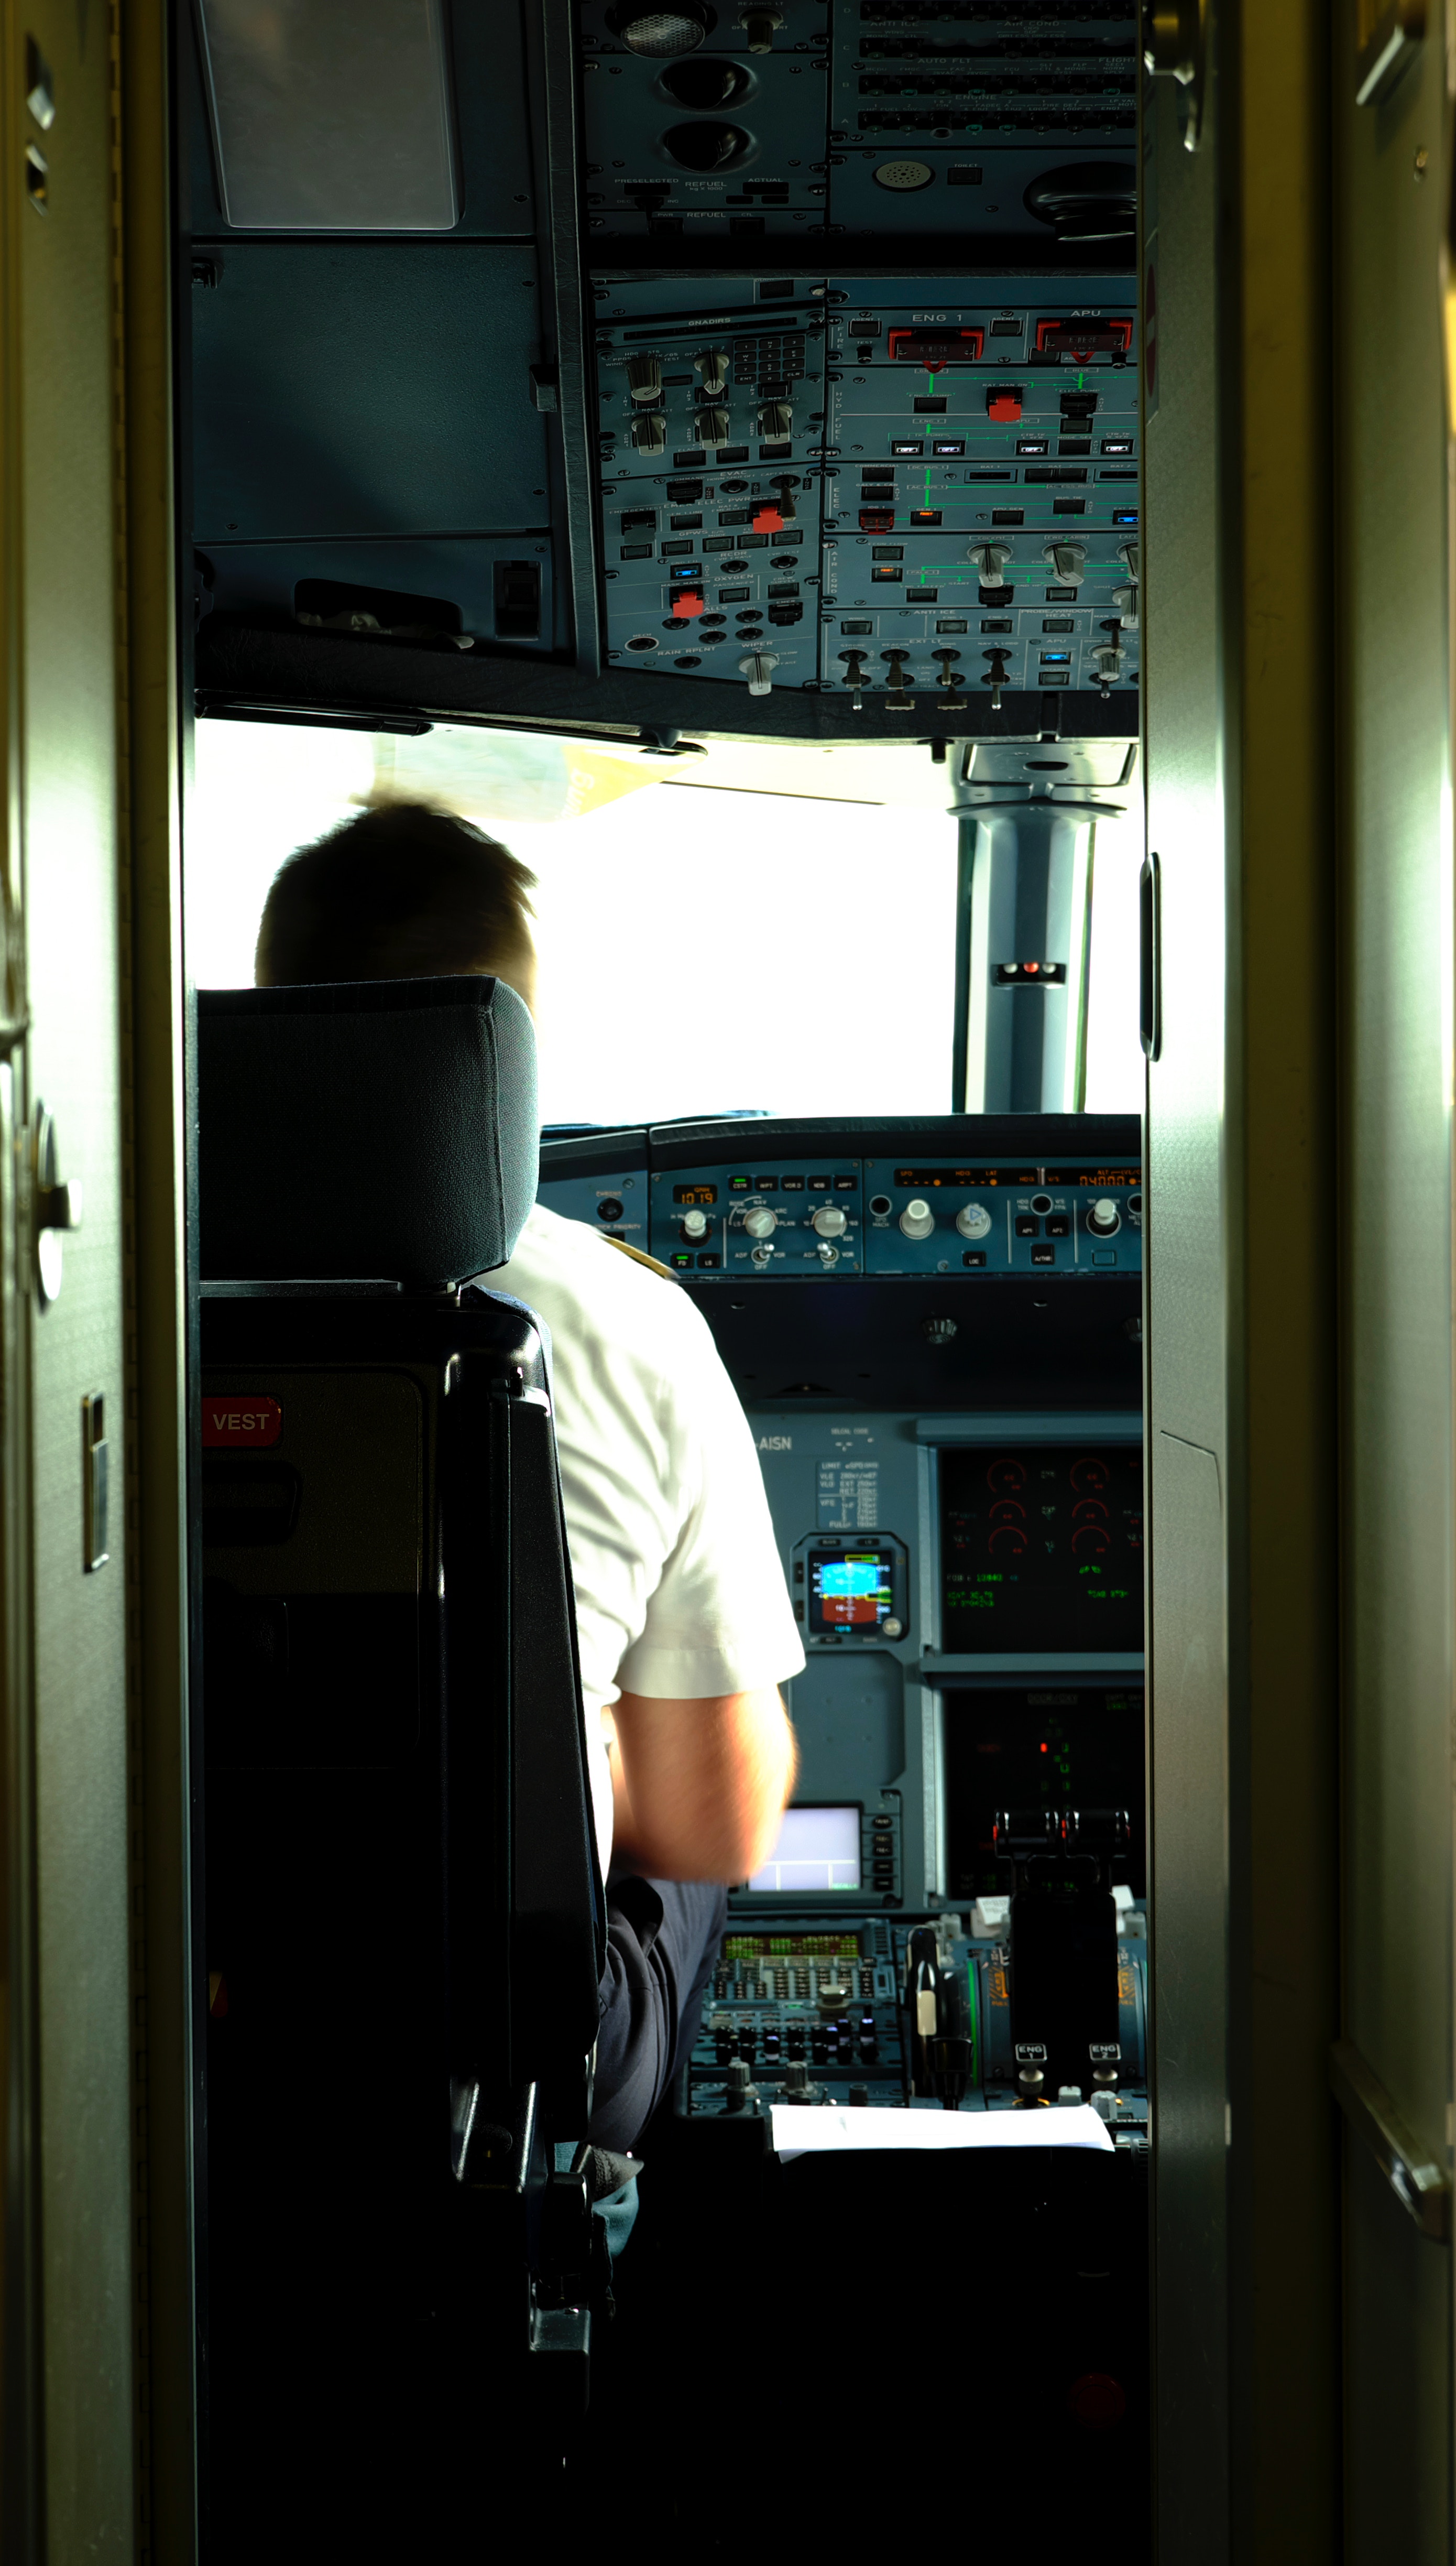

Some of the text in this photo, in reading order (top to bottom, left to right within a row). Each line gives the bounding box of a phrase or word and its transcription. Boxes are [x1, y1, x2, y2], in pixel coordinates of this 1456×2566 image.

[688, 317, 731, 327] GNADIRS
[1080, 1176, 1126, 1186] 04000
[682, 1193, 714, 1204] 1019
[212, 1414, 270, 1430] VEST
